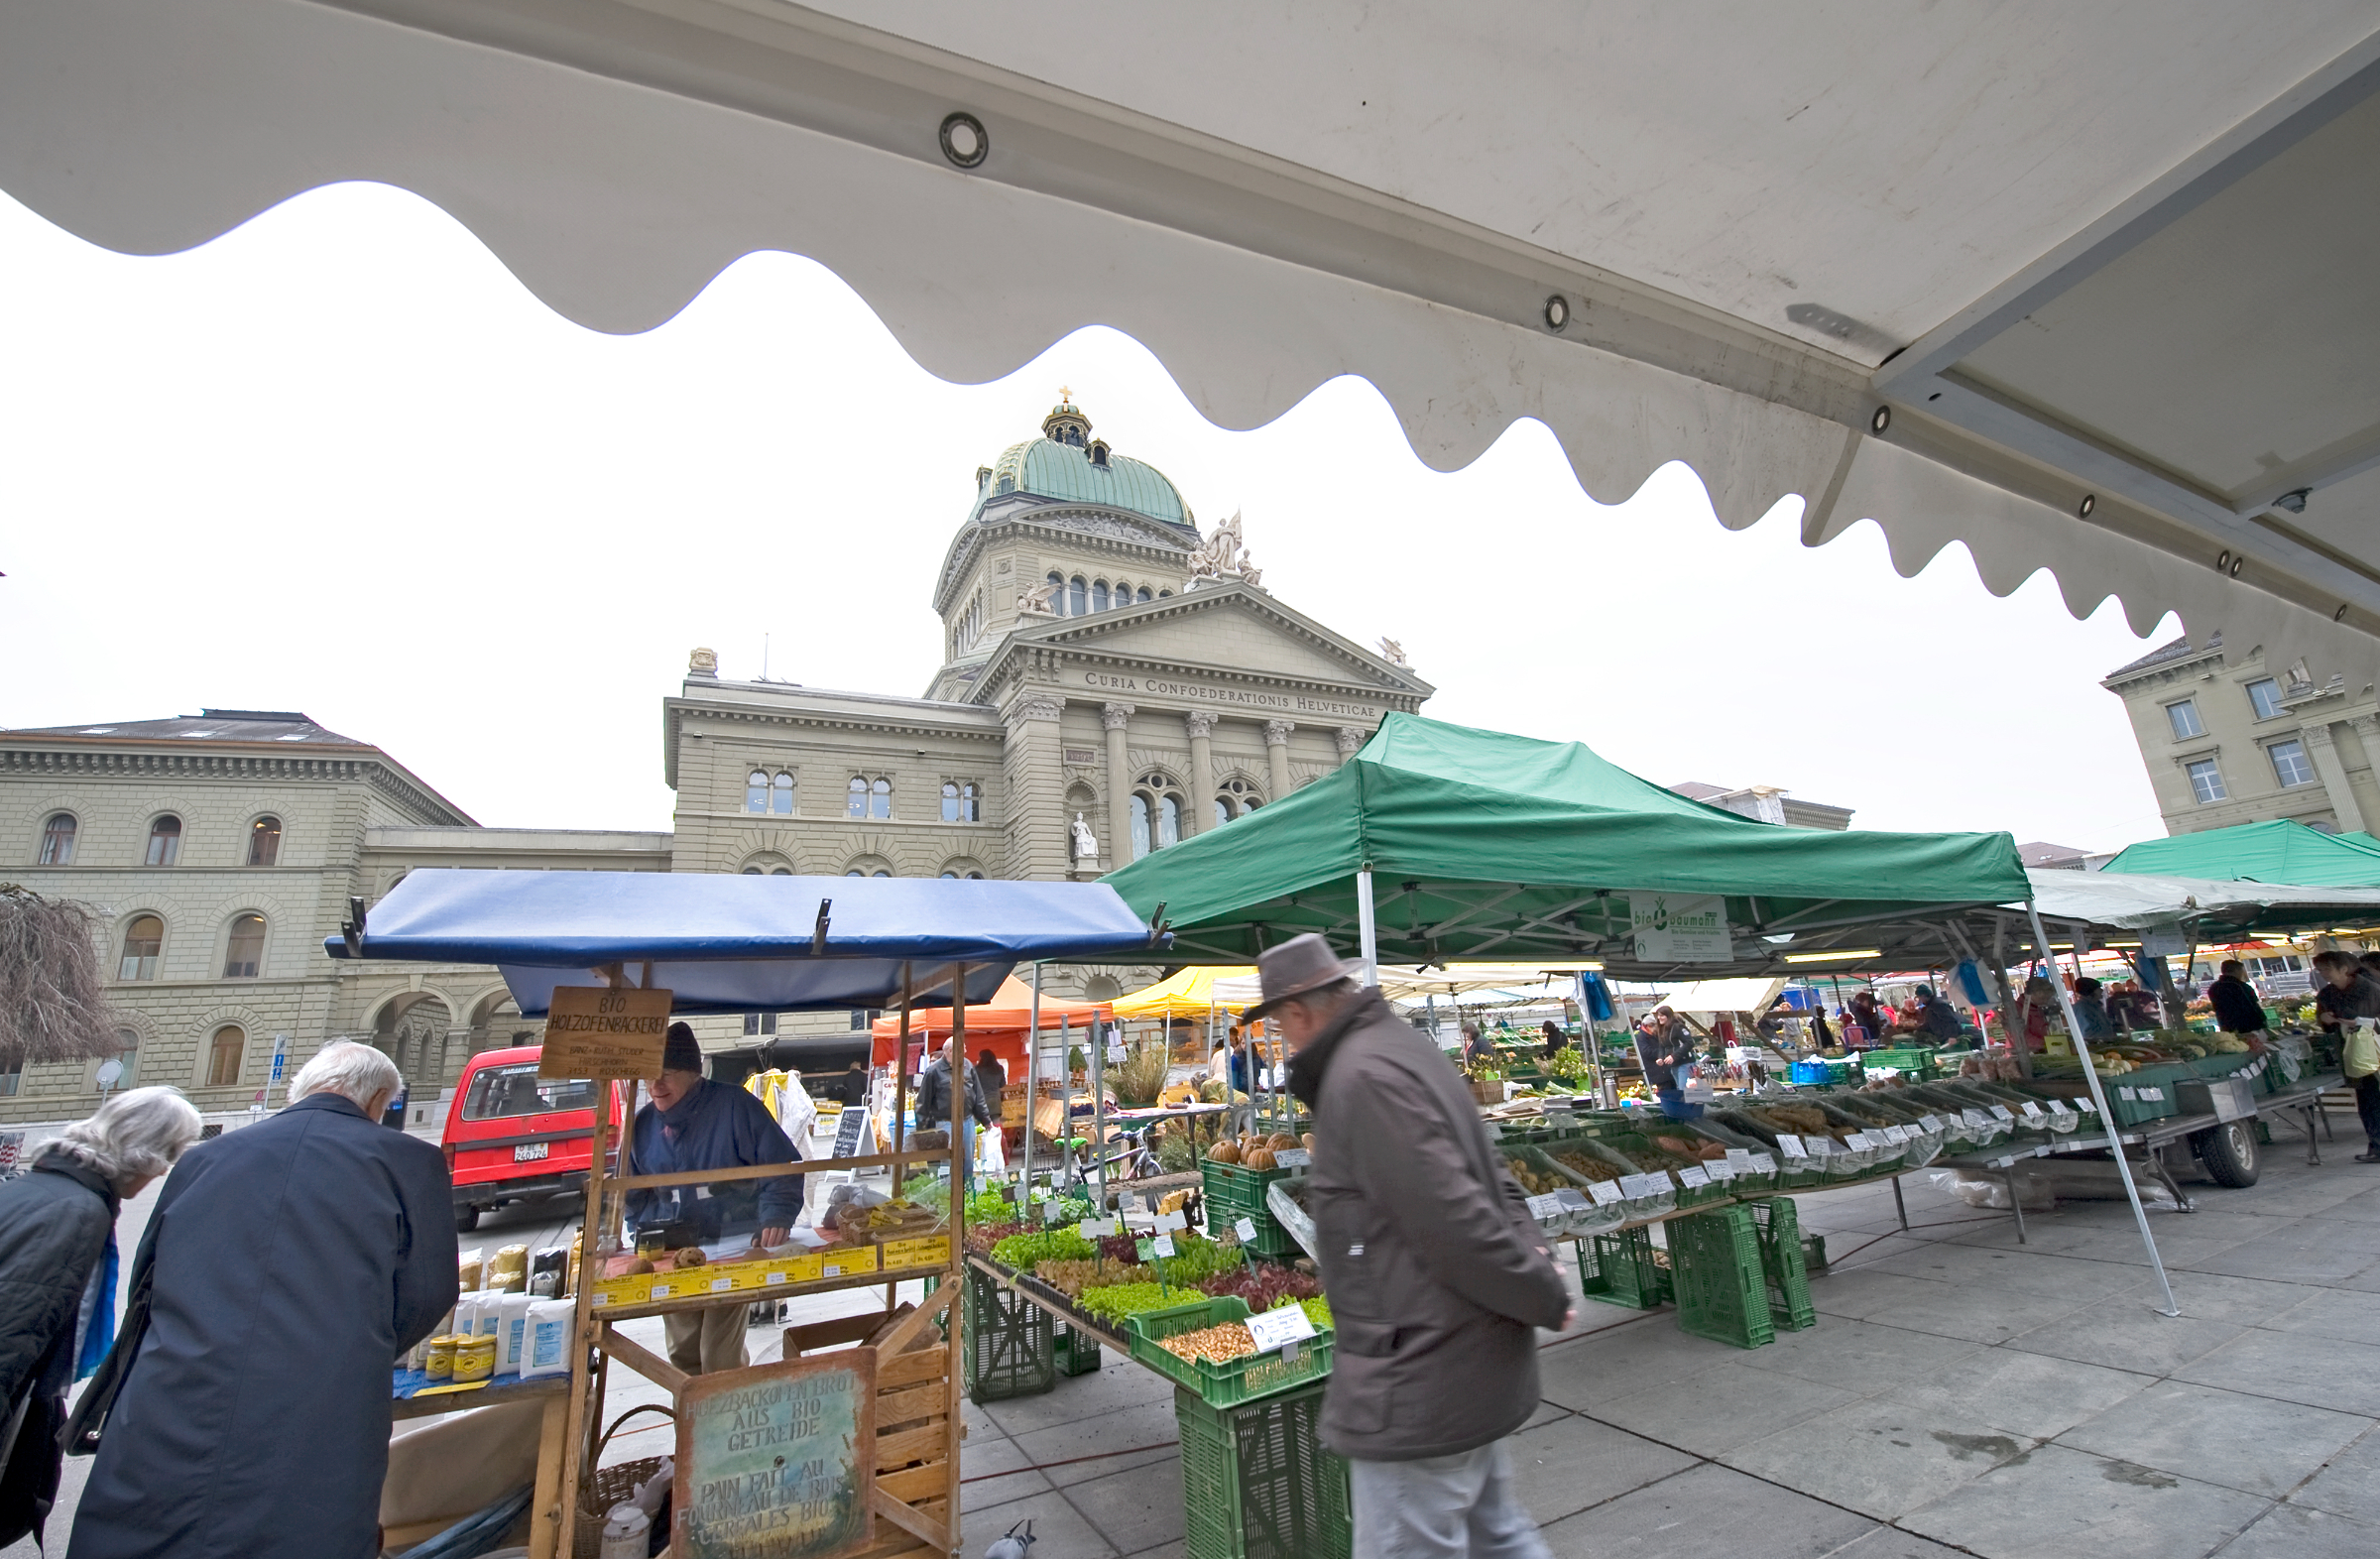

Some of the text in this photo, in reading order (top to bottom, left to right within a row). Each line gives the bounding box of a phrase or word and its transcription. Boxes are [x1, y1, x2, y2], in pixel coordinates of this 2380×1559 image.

[1085, 672, 1375, 718] CURIA CONFOEDERATIONIS HELVETICAE
[599, 998, 626, 1014] BIO
[550, 1015, 665, 1034] HOLZOFENBÄCKEREI
[618, 1047, 645, 1056] STUDER
[732, 1398, 821, 1431] AUS BIO
[728, 1417, 820, 1452] GETREIDE
[700, 1477, 740, 1503] PAIN
[800, 1459, 824, 1479] AU
[676, 1492, 772, 1530] FOURNEAU
[778, 1484, 801, 1506] DE
[800, 1498, 829, 1522] BIO
